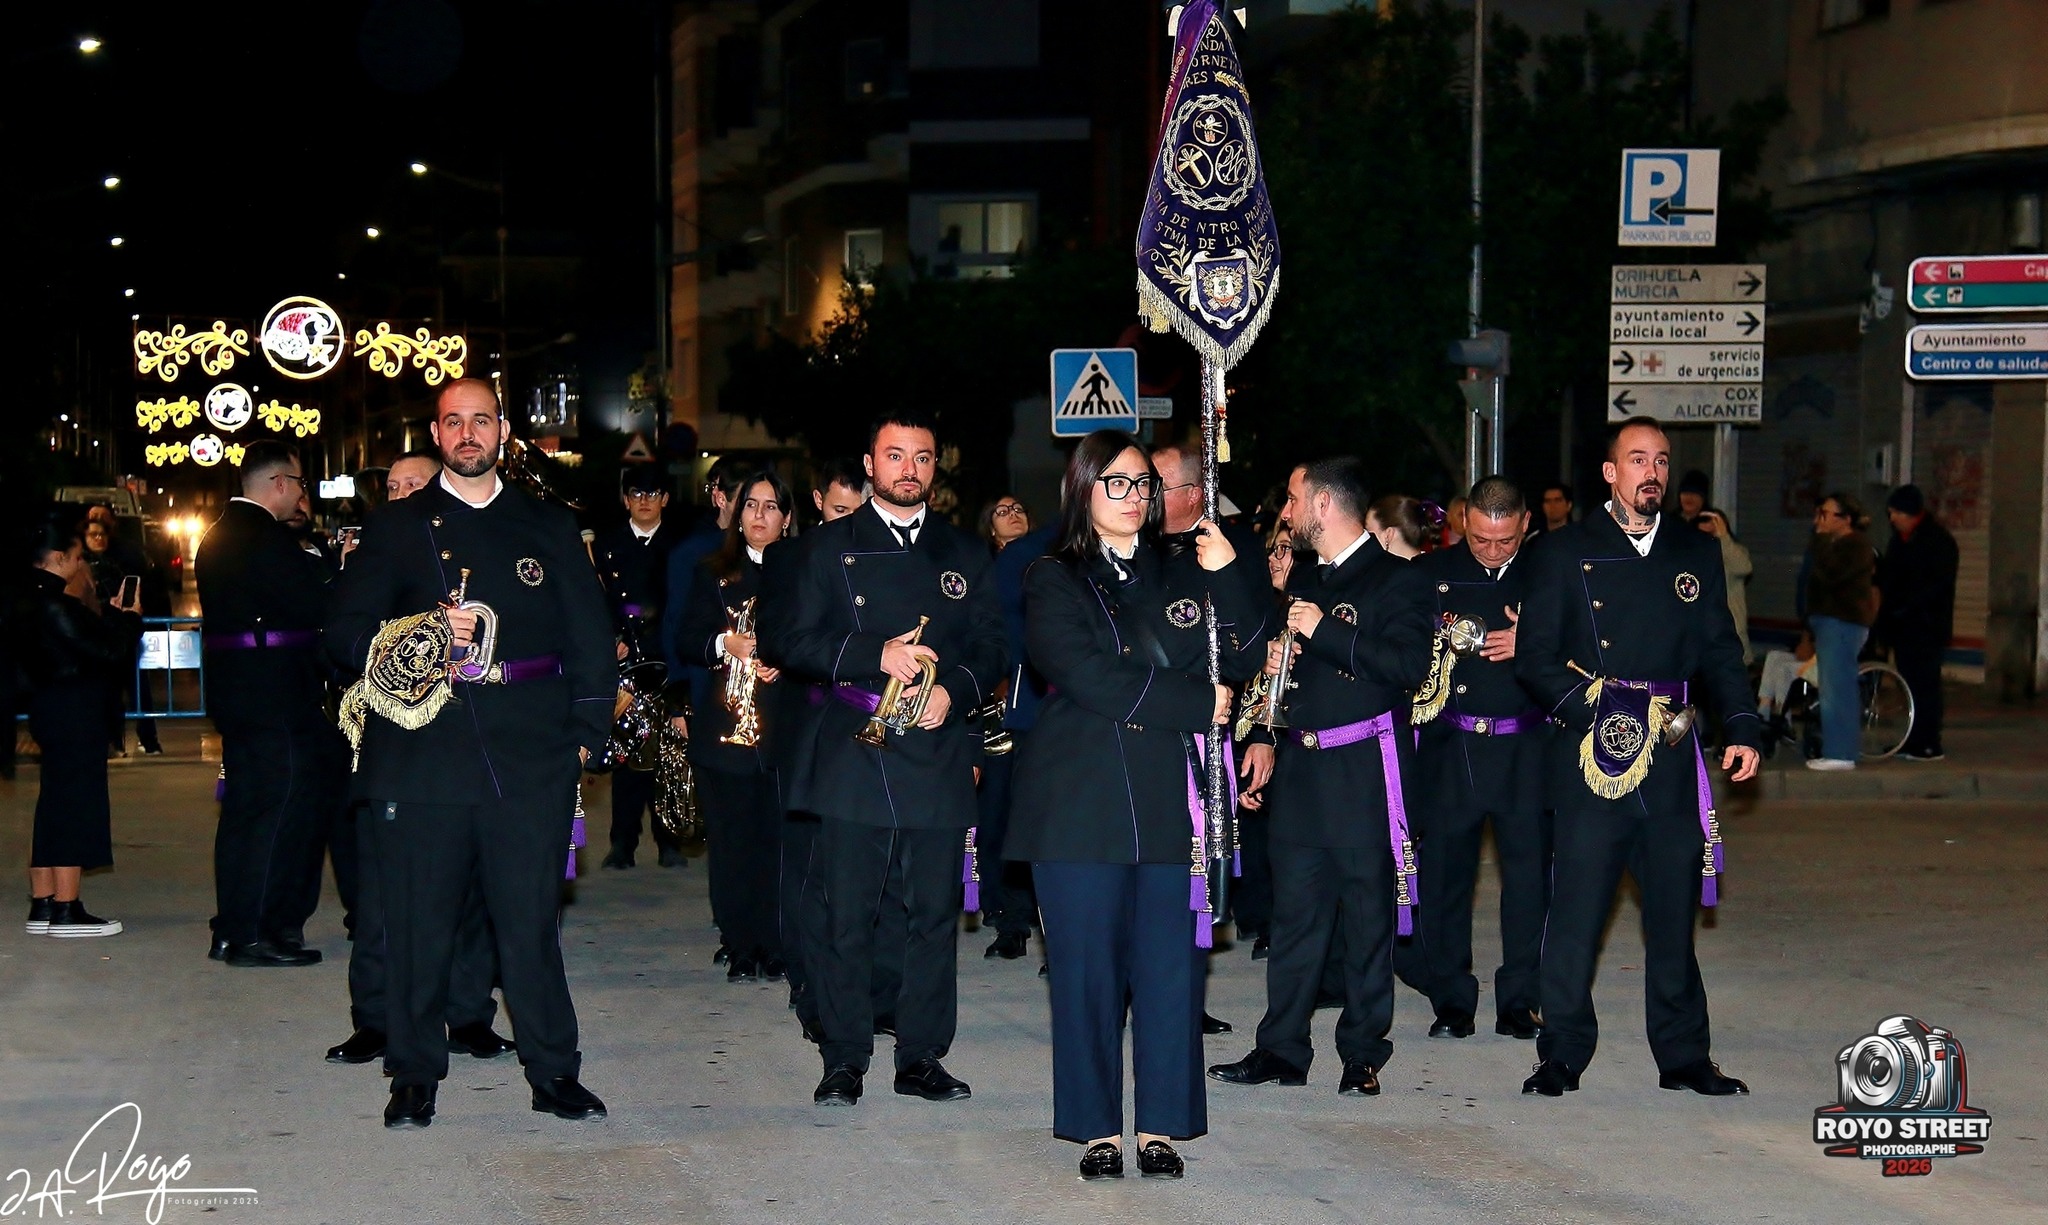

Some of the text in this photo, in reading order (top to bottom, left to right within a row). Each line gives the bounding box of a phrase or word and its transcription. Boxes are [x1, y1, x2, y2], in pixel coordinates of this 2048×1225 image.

[1197, 39, 1224, 52] NDA
[1183, 70, 1208, 90] RES
[1630, 157, 1683, 222] P
[1170, 212, 1190, 229] DE
[1196, 220, 1240, 235] NTRO.
[1198, 236, 1217, 250] DE
[1225, 234, 1242, 248] LA
[1622, 230, 1666, 242] PARKING
[1614, 268, 1702, 283] ORIHUELA
[1614, 284, 1680, 299] MURCIA
[1614, 309, 1725, 324] ayuntamiento
[1670, 325, 1707, 338] local
[1922, 334, 2027, 348] Ayuntamiento
[1709, 349, 1761, 362] servicio
[1921, 356, 2040, 370] Centro de salud
[1677, 364, 1760, 380] de urgencias
[1724, 387, 1759, 401] COX
[1674, 403, 1759, 419] ALICANTE
